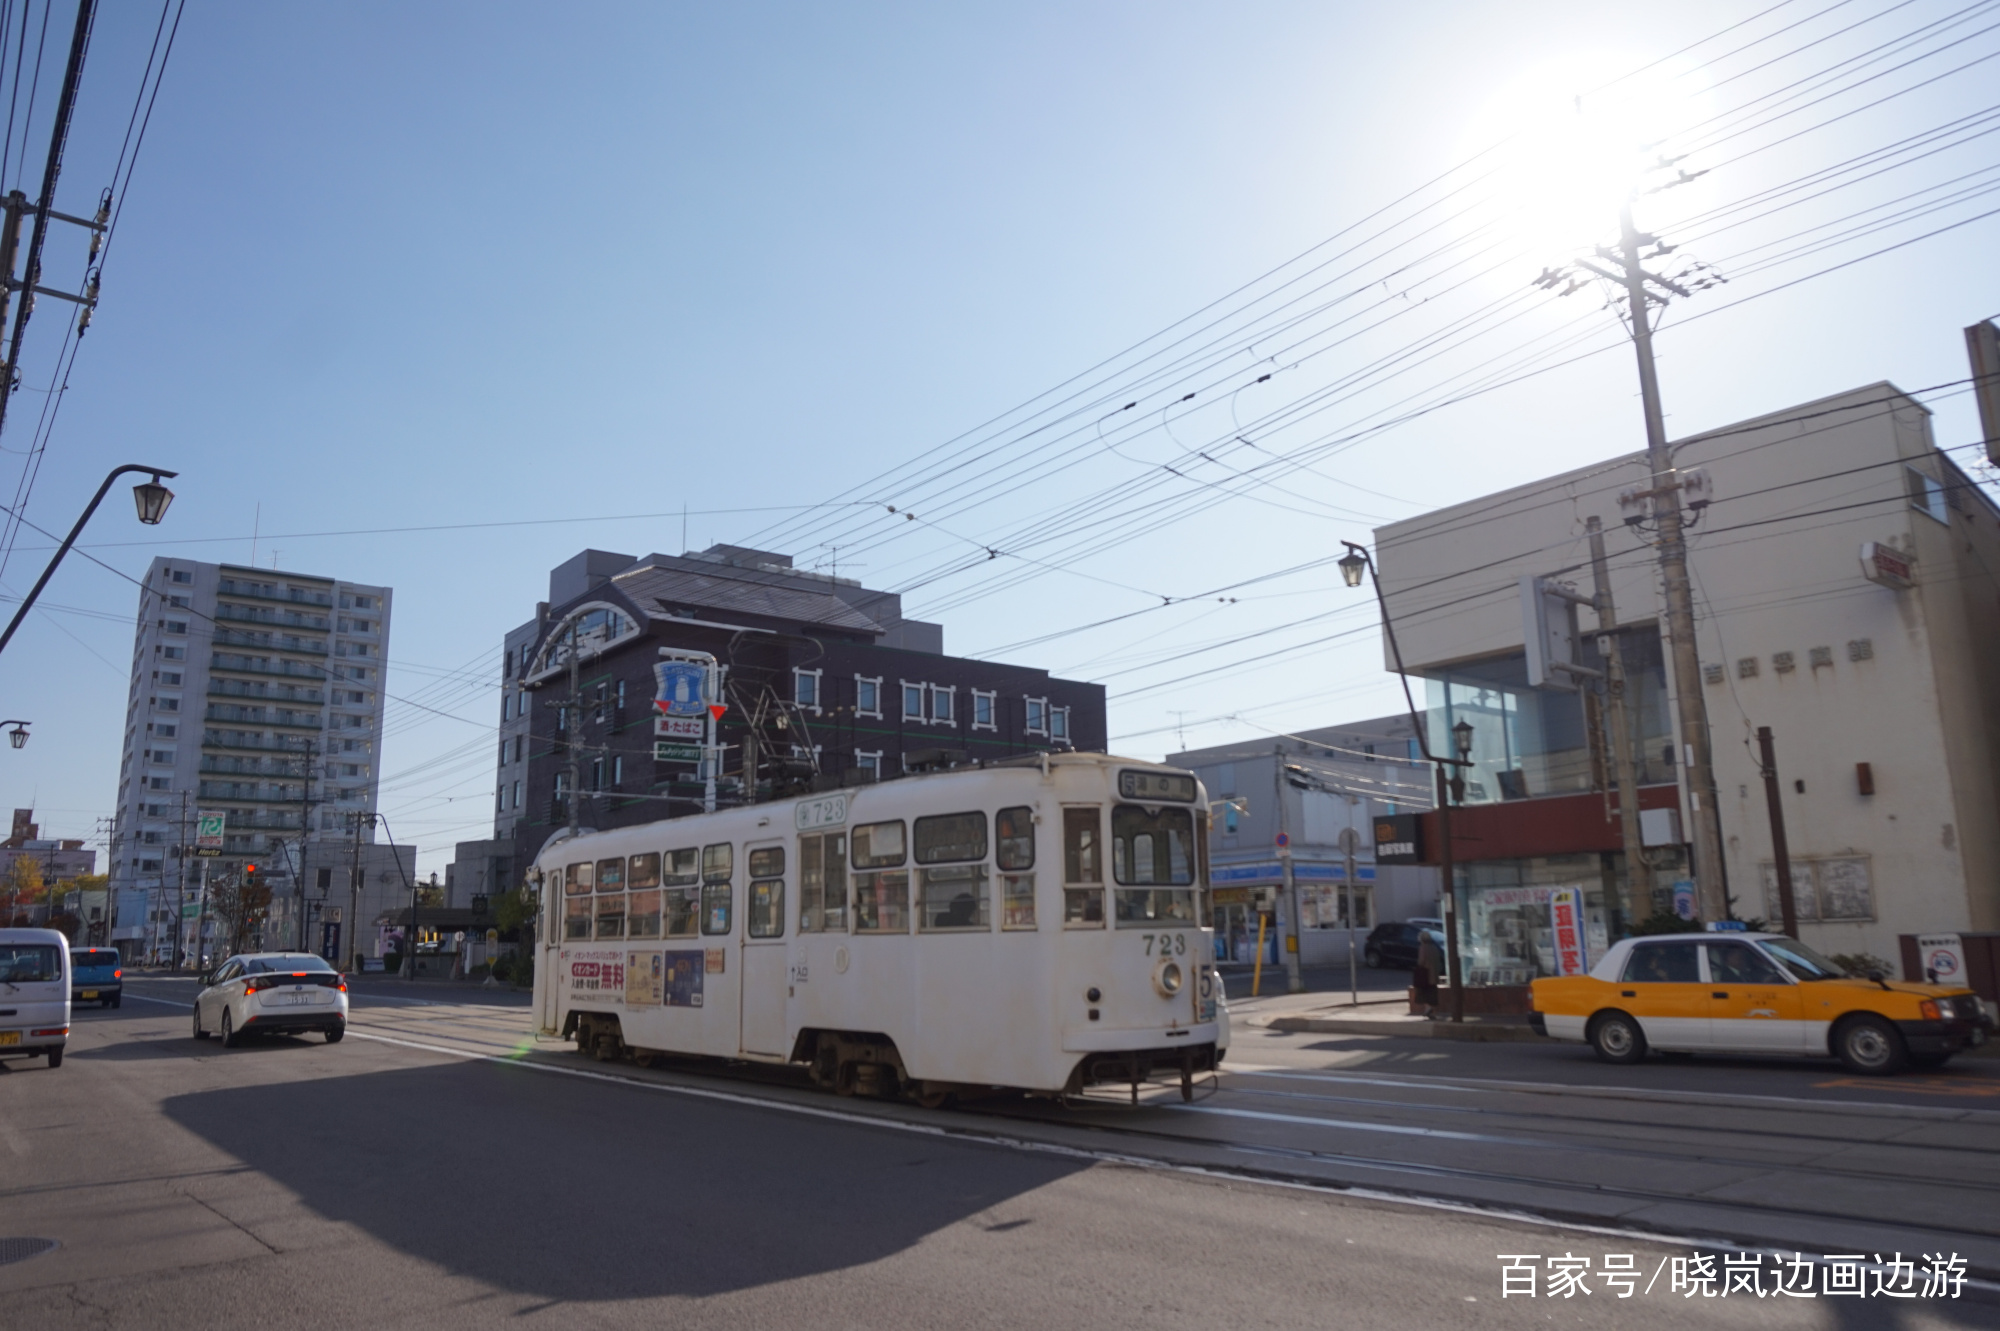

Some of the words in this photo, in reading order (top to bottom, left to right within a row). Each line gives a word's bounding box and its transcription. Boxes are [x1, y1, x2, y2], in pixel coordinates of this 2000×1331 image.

[813, 798, 844, 822] 723
[1142, 934, 1186, 957] 723
[572, 963, 599, 976] イオンカード
[601, 962, 624, 990] 無料
[1201, 965, 1212, 998] 5
